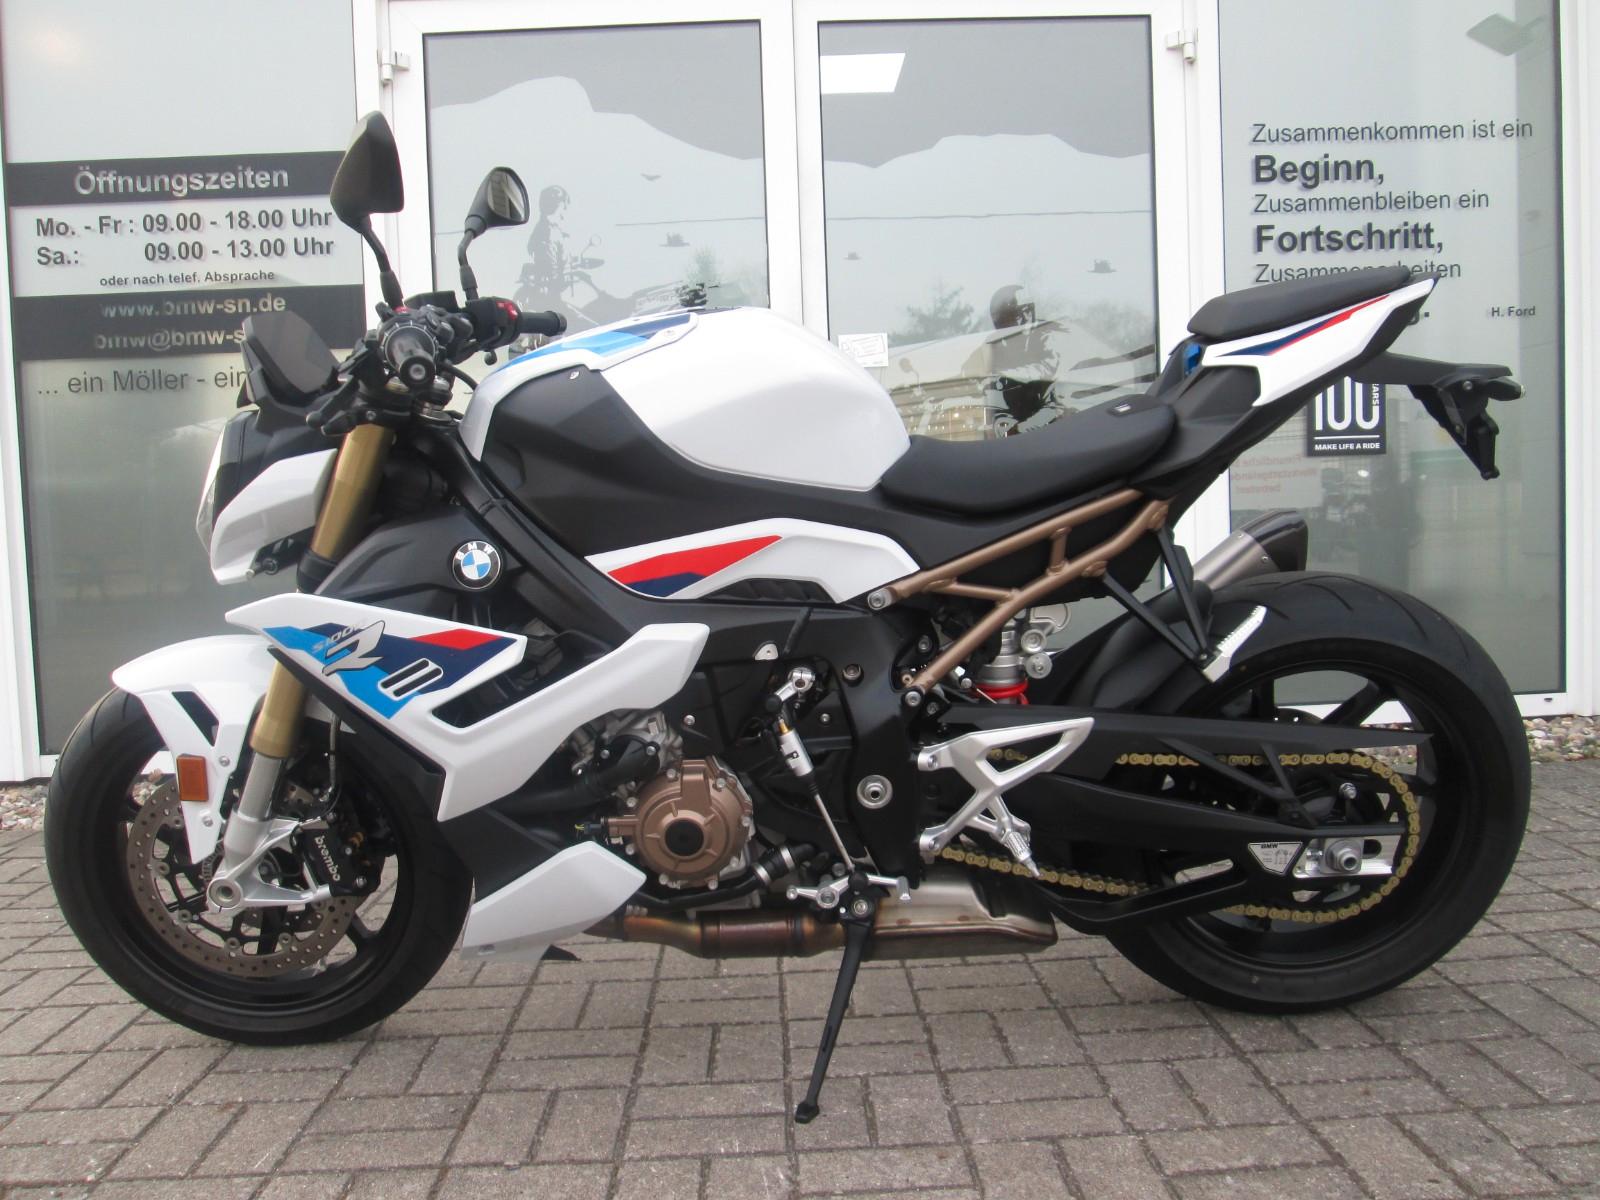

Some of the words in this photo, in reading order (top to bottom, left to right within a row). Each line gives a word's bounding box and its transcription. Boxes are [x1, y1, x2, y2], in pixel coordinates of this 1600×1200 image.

[1251, 121, 1465, 143] Zusammenkommen
[1471, 120, 1496, 139] ist
[1502, 119, 1533, 138] ein
[74, 166, 289, 197] Öffnungszeiten
[1254, 153, 1385, 190] Beginn,
[1254, 191, 1451, 213] Zusammenbleiben
[1458, 189, 1490, 208] ein
[36, 217, 76, 237] Mo.
[142, 212, 202, 233] 09.00
[225, 209, 284, 230] 18.00
[292, 207, 333, 227] Uhr
[1256, 221, 1443, 253] Fortschritt,
[37, 246, 79, 266] Sa.:
[144, 241, 204, 262] 09.00
[227, 238, 286, 258] 13.00
[294, 236, 335, 256] Uhr
[100, 275, 129, 287] oder
[133, 273, 165, 285] nach
[169, 272, 201, 284] telef.
[204, 269, 275, 283] Absprache
[102, 293, 287, 318] www.bmw-sn.de
[1491, 306, 1505, 318] H.
[1508, 305, 1536, 317] Ford
[67, 370, 104, 394] ein
[113, 368, 189, 392] Möller
[1314, 443, 1338, 451] MAKE
[1339, 442, 1355, 450] LIFE
[1363, 441, 1381, 449] RIDE
[314, 834, 341, 882] brembo
